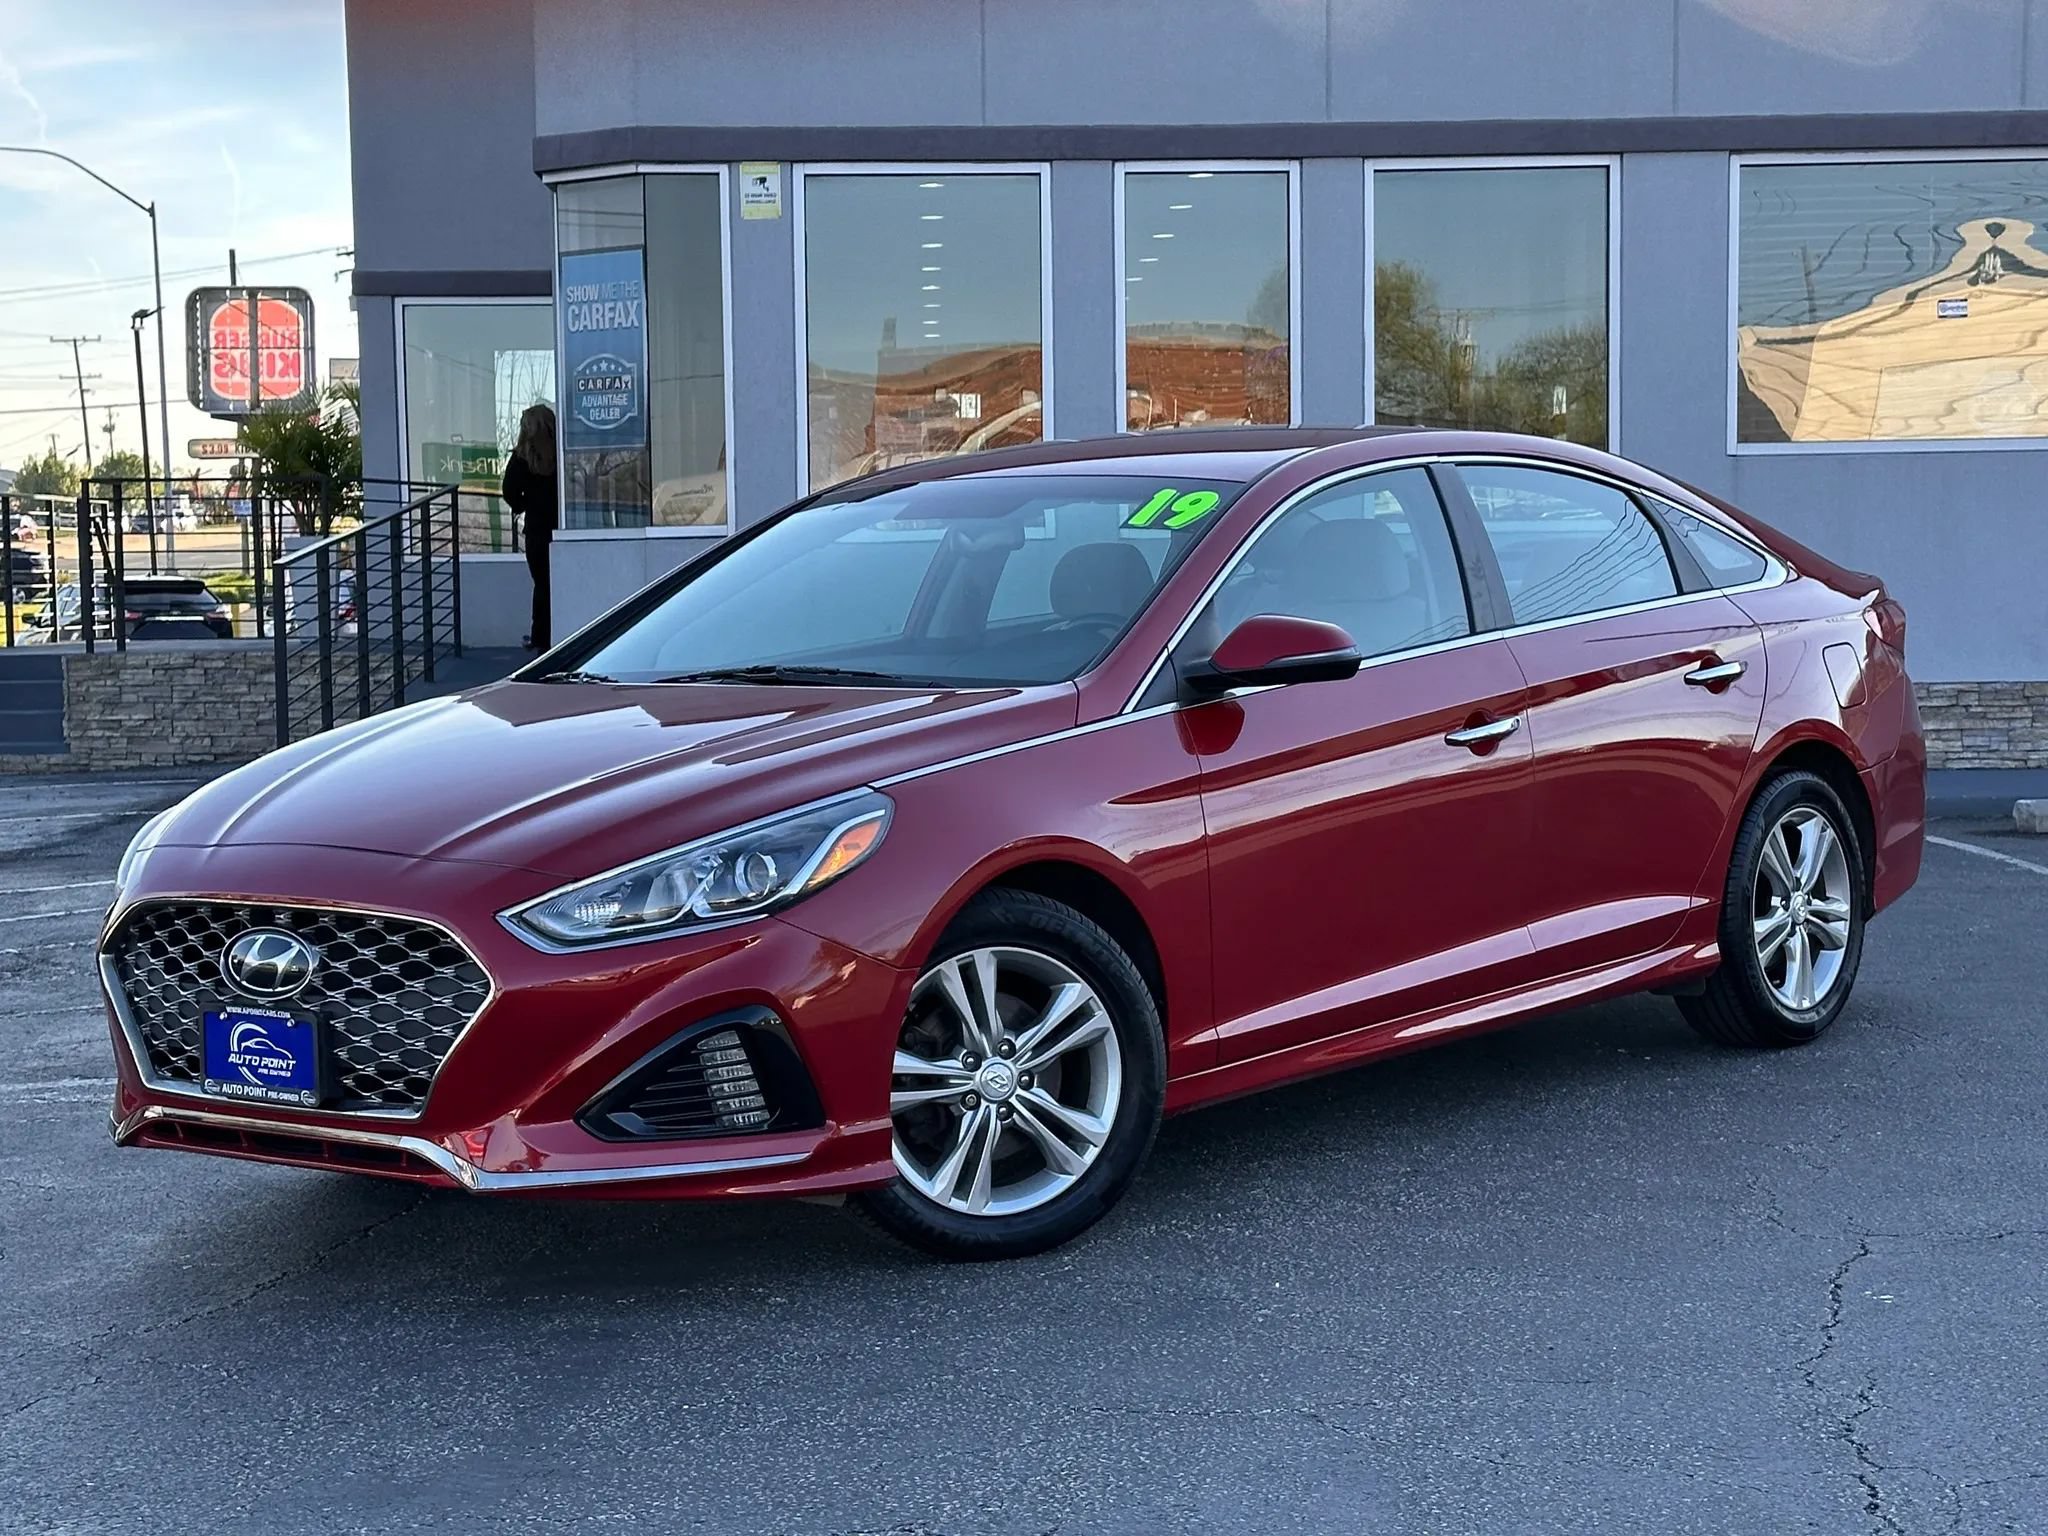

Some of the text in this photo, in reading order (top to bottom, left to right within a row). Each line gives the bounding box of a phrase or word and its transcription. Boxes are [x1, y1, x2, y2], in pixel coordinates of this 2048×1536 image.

[566, 280, 639, 302] SHOW ME THE
[567, 301, 641, 332] CARFAX
[578, 375, 632, 391] CARFAX
[581, 393, 628, 408] ADVANTAGE
[589, 407, 621, 420] DEALER
[1127, 488, 1221, 529] 19
[228, 1053, 296, 1071] AUTO POINT
[221, 1083, 243, 1095] AUTO
[243, 1086, 267, 1098] POINT
